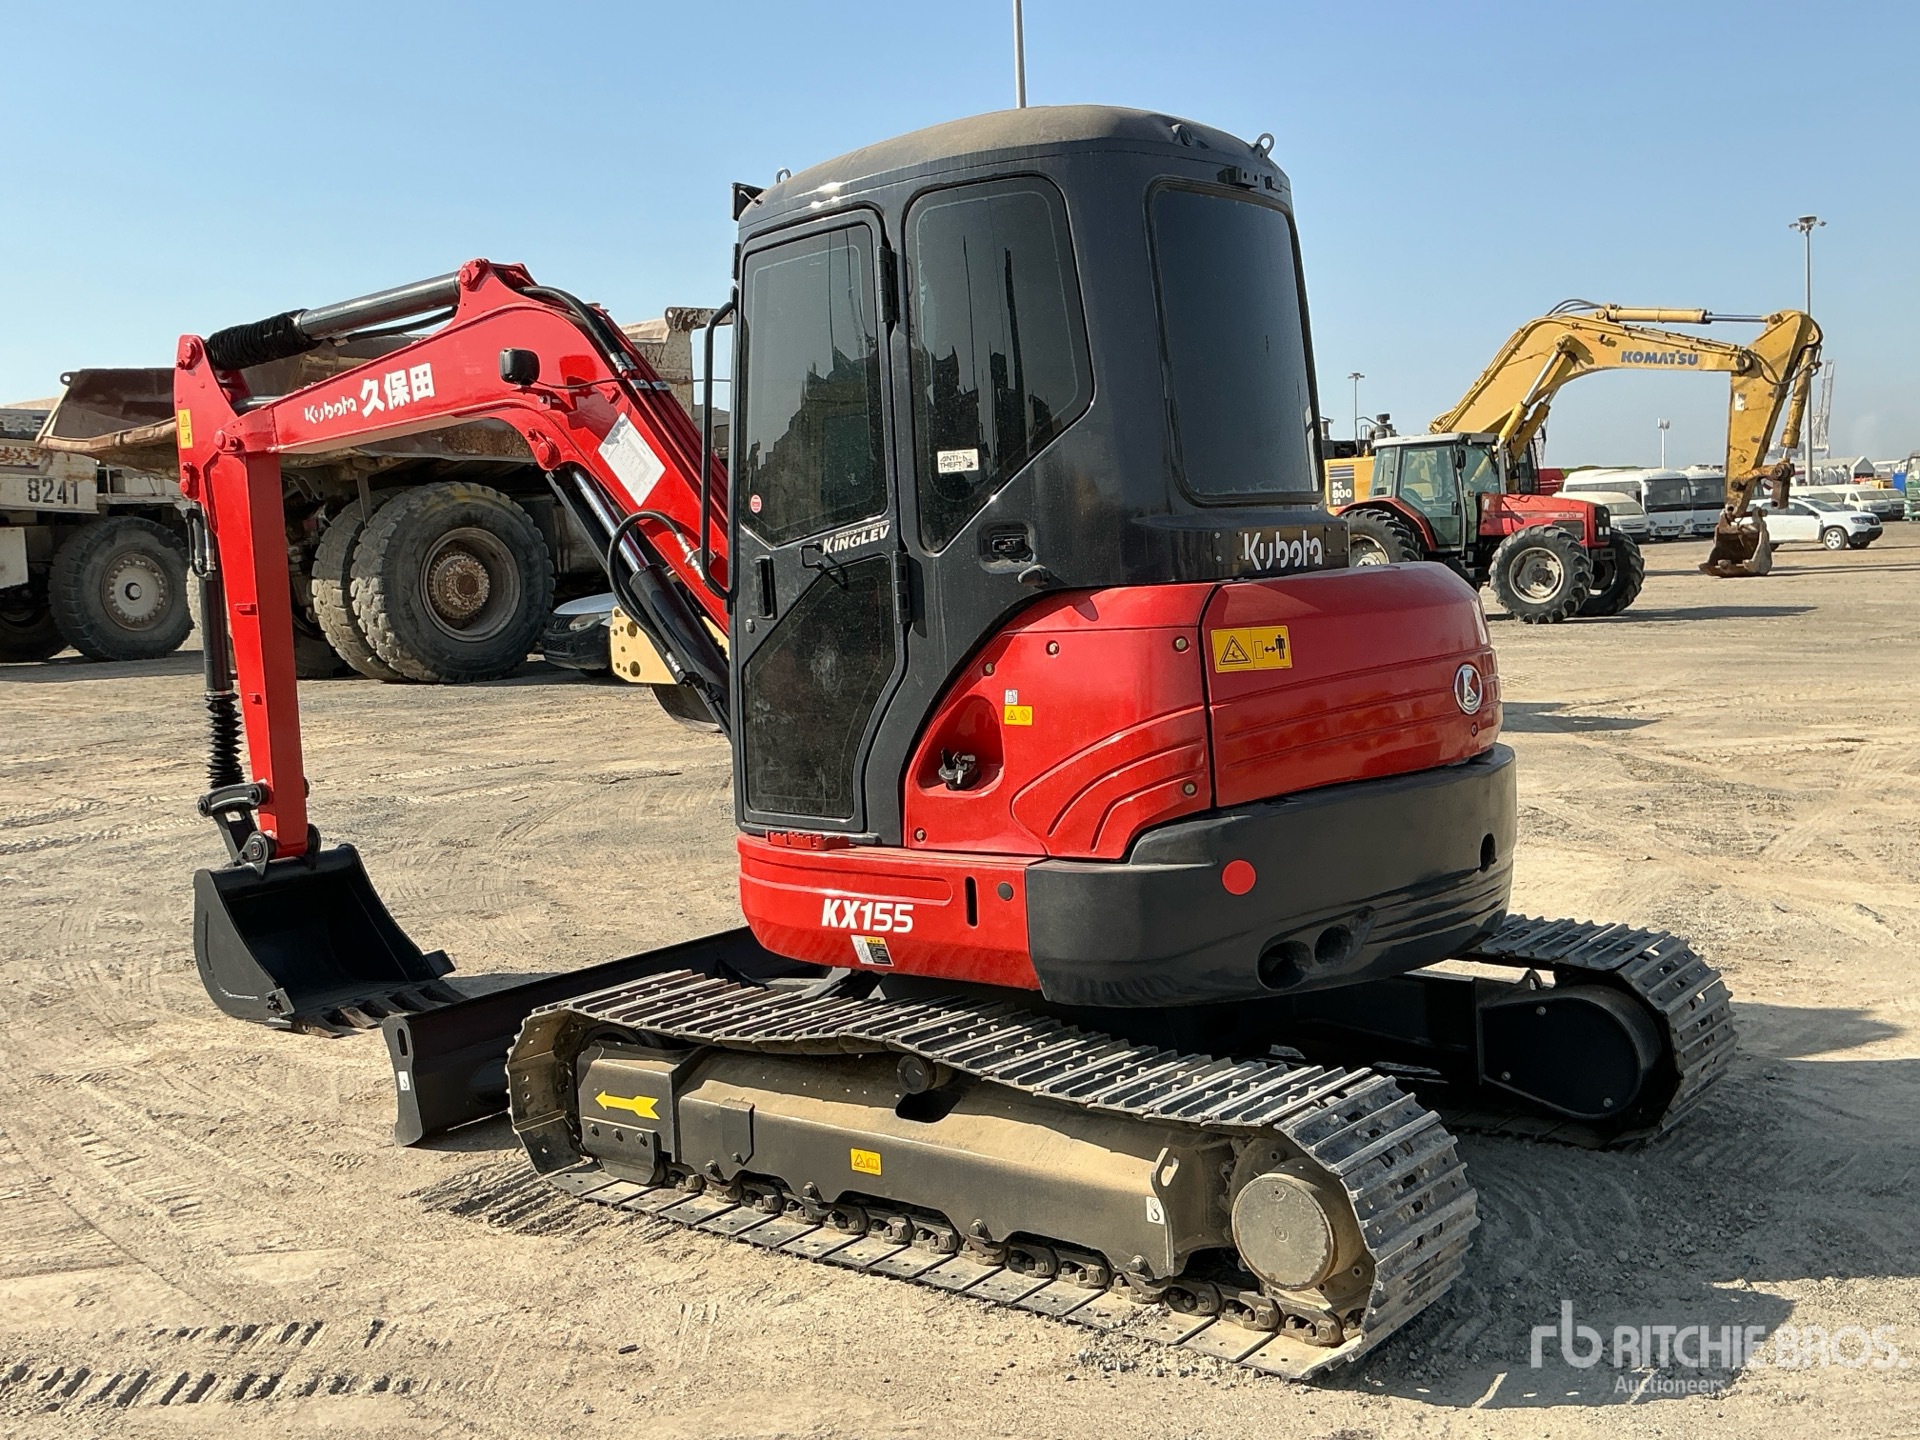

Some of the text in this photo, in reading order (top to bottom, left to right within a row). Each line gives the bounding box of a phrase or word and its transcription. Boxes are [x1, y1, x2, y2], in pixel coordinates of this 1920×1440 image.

[1620, 350, 1698, 366] KOMATSU
[360, 362, 435, 418] 久保田
[304, 395, 357, 424] Kubota
[940, 461, 962, 469] THEFT
[27, 477, 79, 505] 8241
[1332, 481, 1342, 489] PC
[1332, 488, 1352, 499] 800
[823, 524, 891, 555] KINGLEV
[1244, 529, 1323, 571] Kubota
[821, 898, 914, 933] KX155
